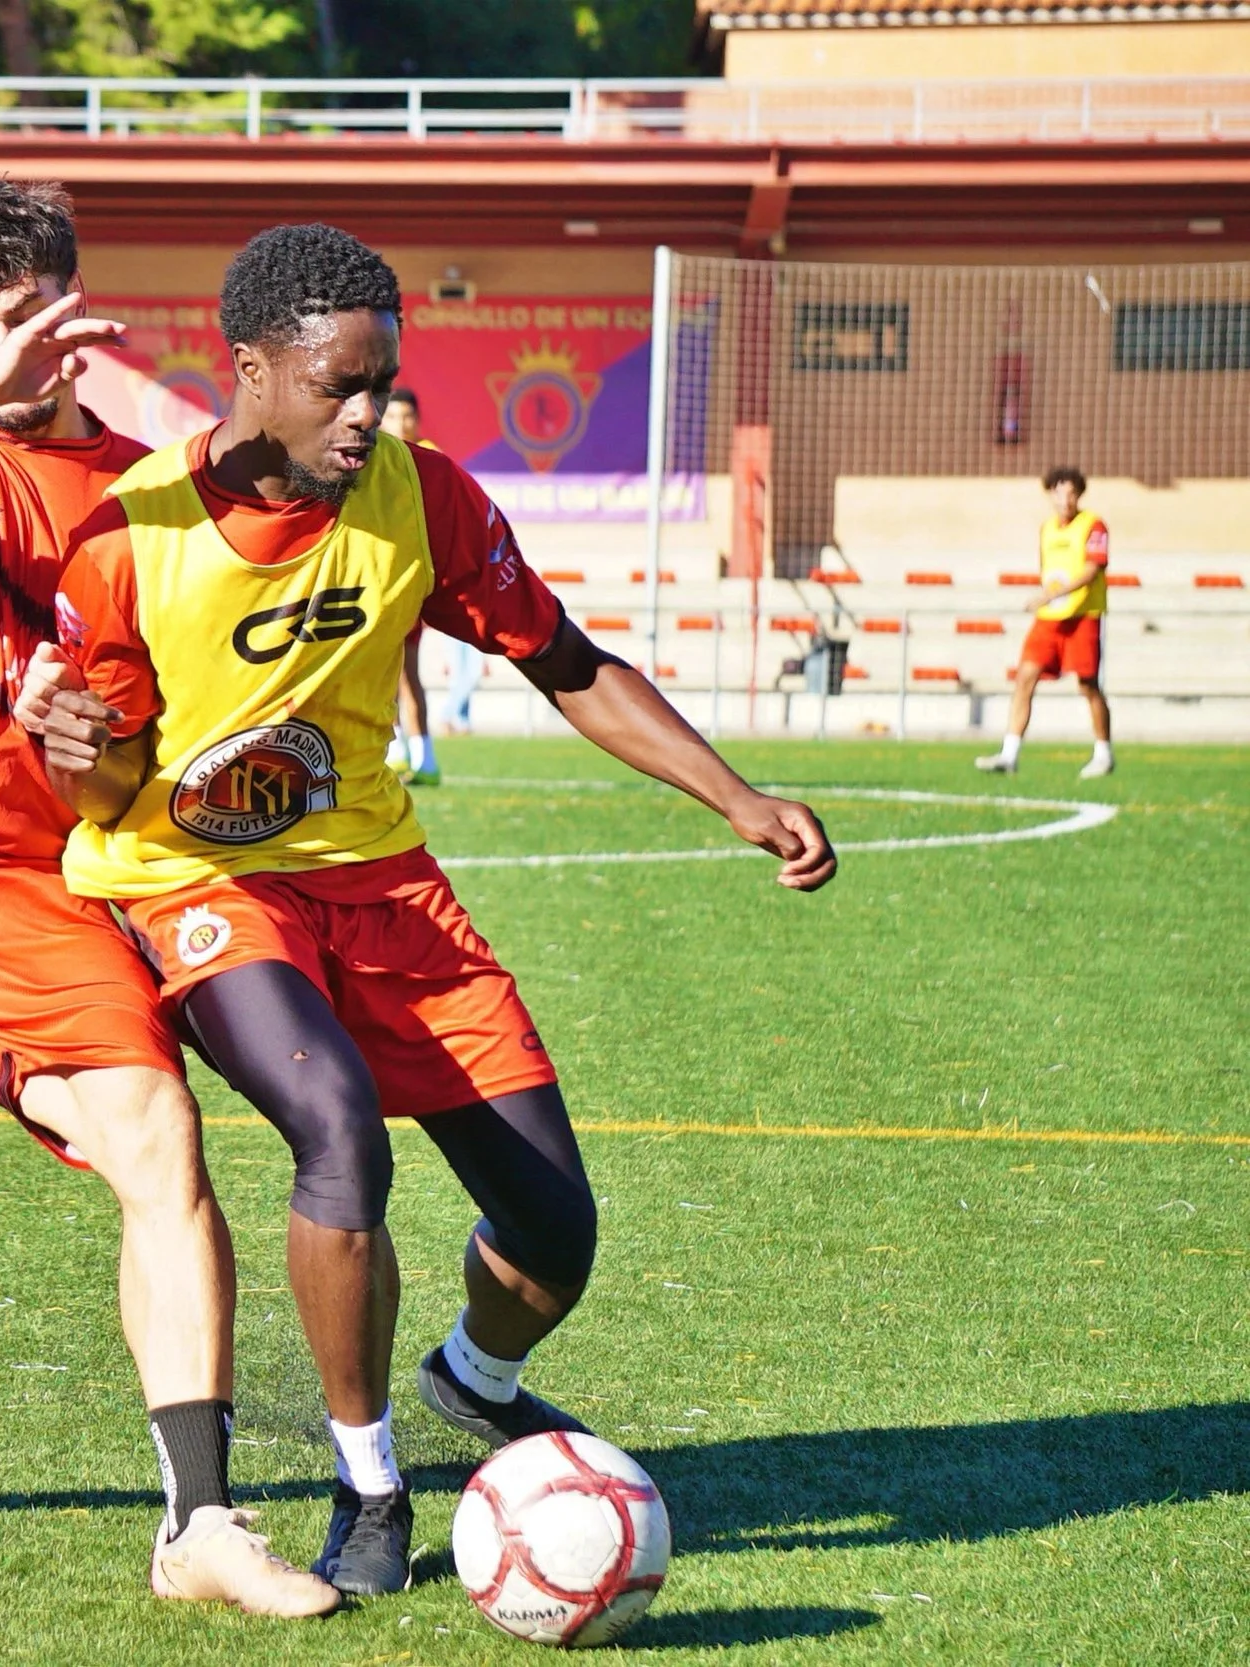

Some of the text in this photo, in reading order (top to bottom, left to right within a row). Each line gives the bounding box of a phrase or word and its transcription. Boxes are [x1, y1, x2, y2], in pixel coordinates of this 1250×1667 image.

[273, 729, 322, 769] MADRID
[192, 812, 286, 834] 1914 FÚTBO
[497, 1605, 568, 1621] KARMA
